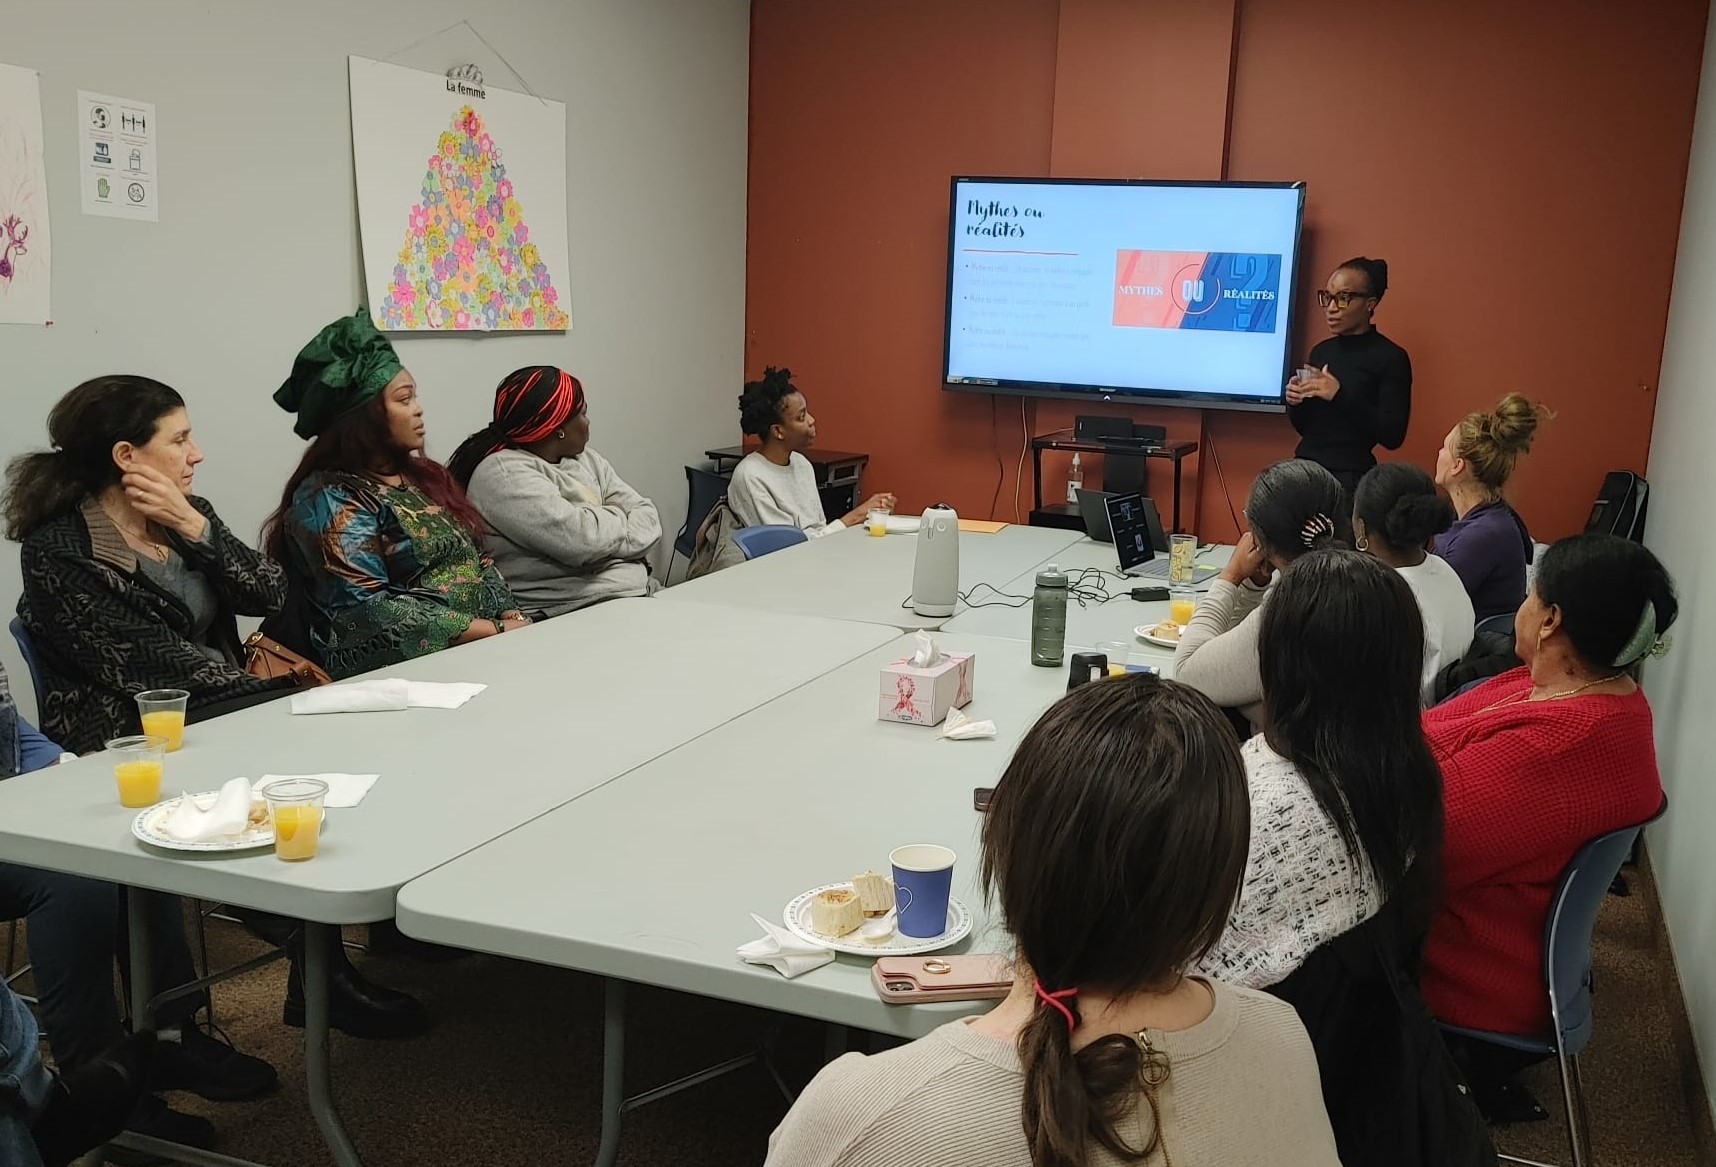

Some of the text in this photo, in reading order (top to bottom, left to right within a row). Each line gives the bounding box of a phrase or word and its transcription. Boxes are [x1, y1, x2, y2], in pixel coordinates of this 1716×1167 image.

[446, 79, 486, 99] La femme
[967, 199, 1042, 225] Mythes ou
[966, 221, 1025, 238] réalités
[1118, 279, 1275, 303] MYTHES OU RÉALITÉS
